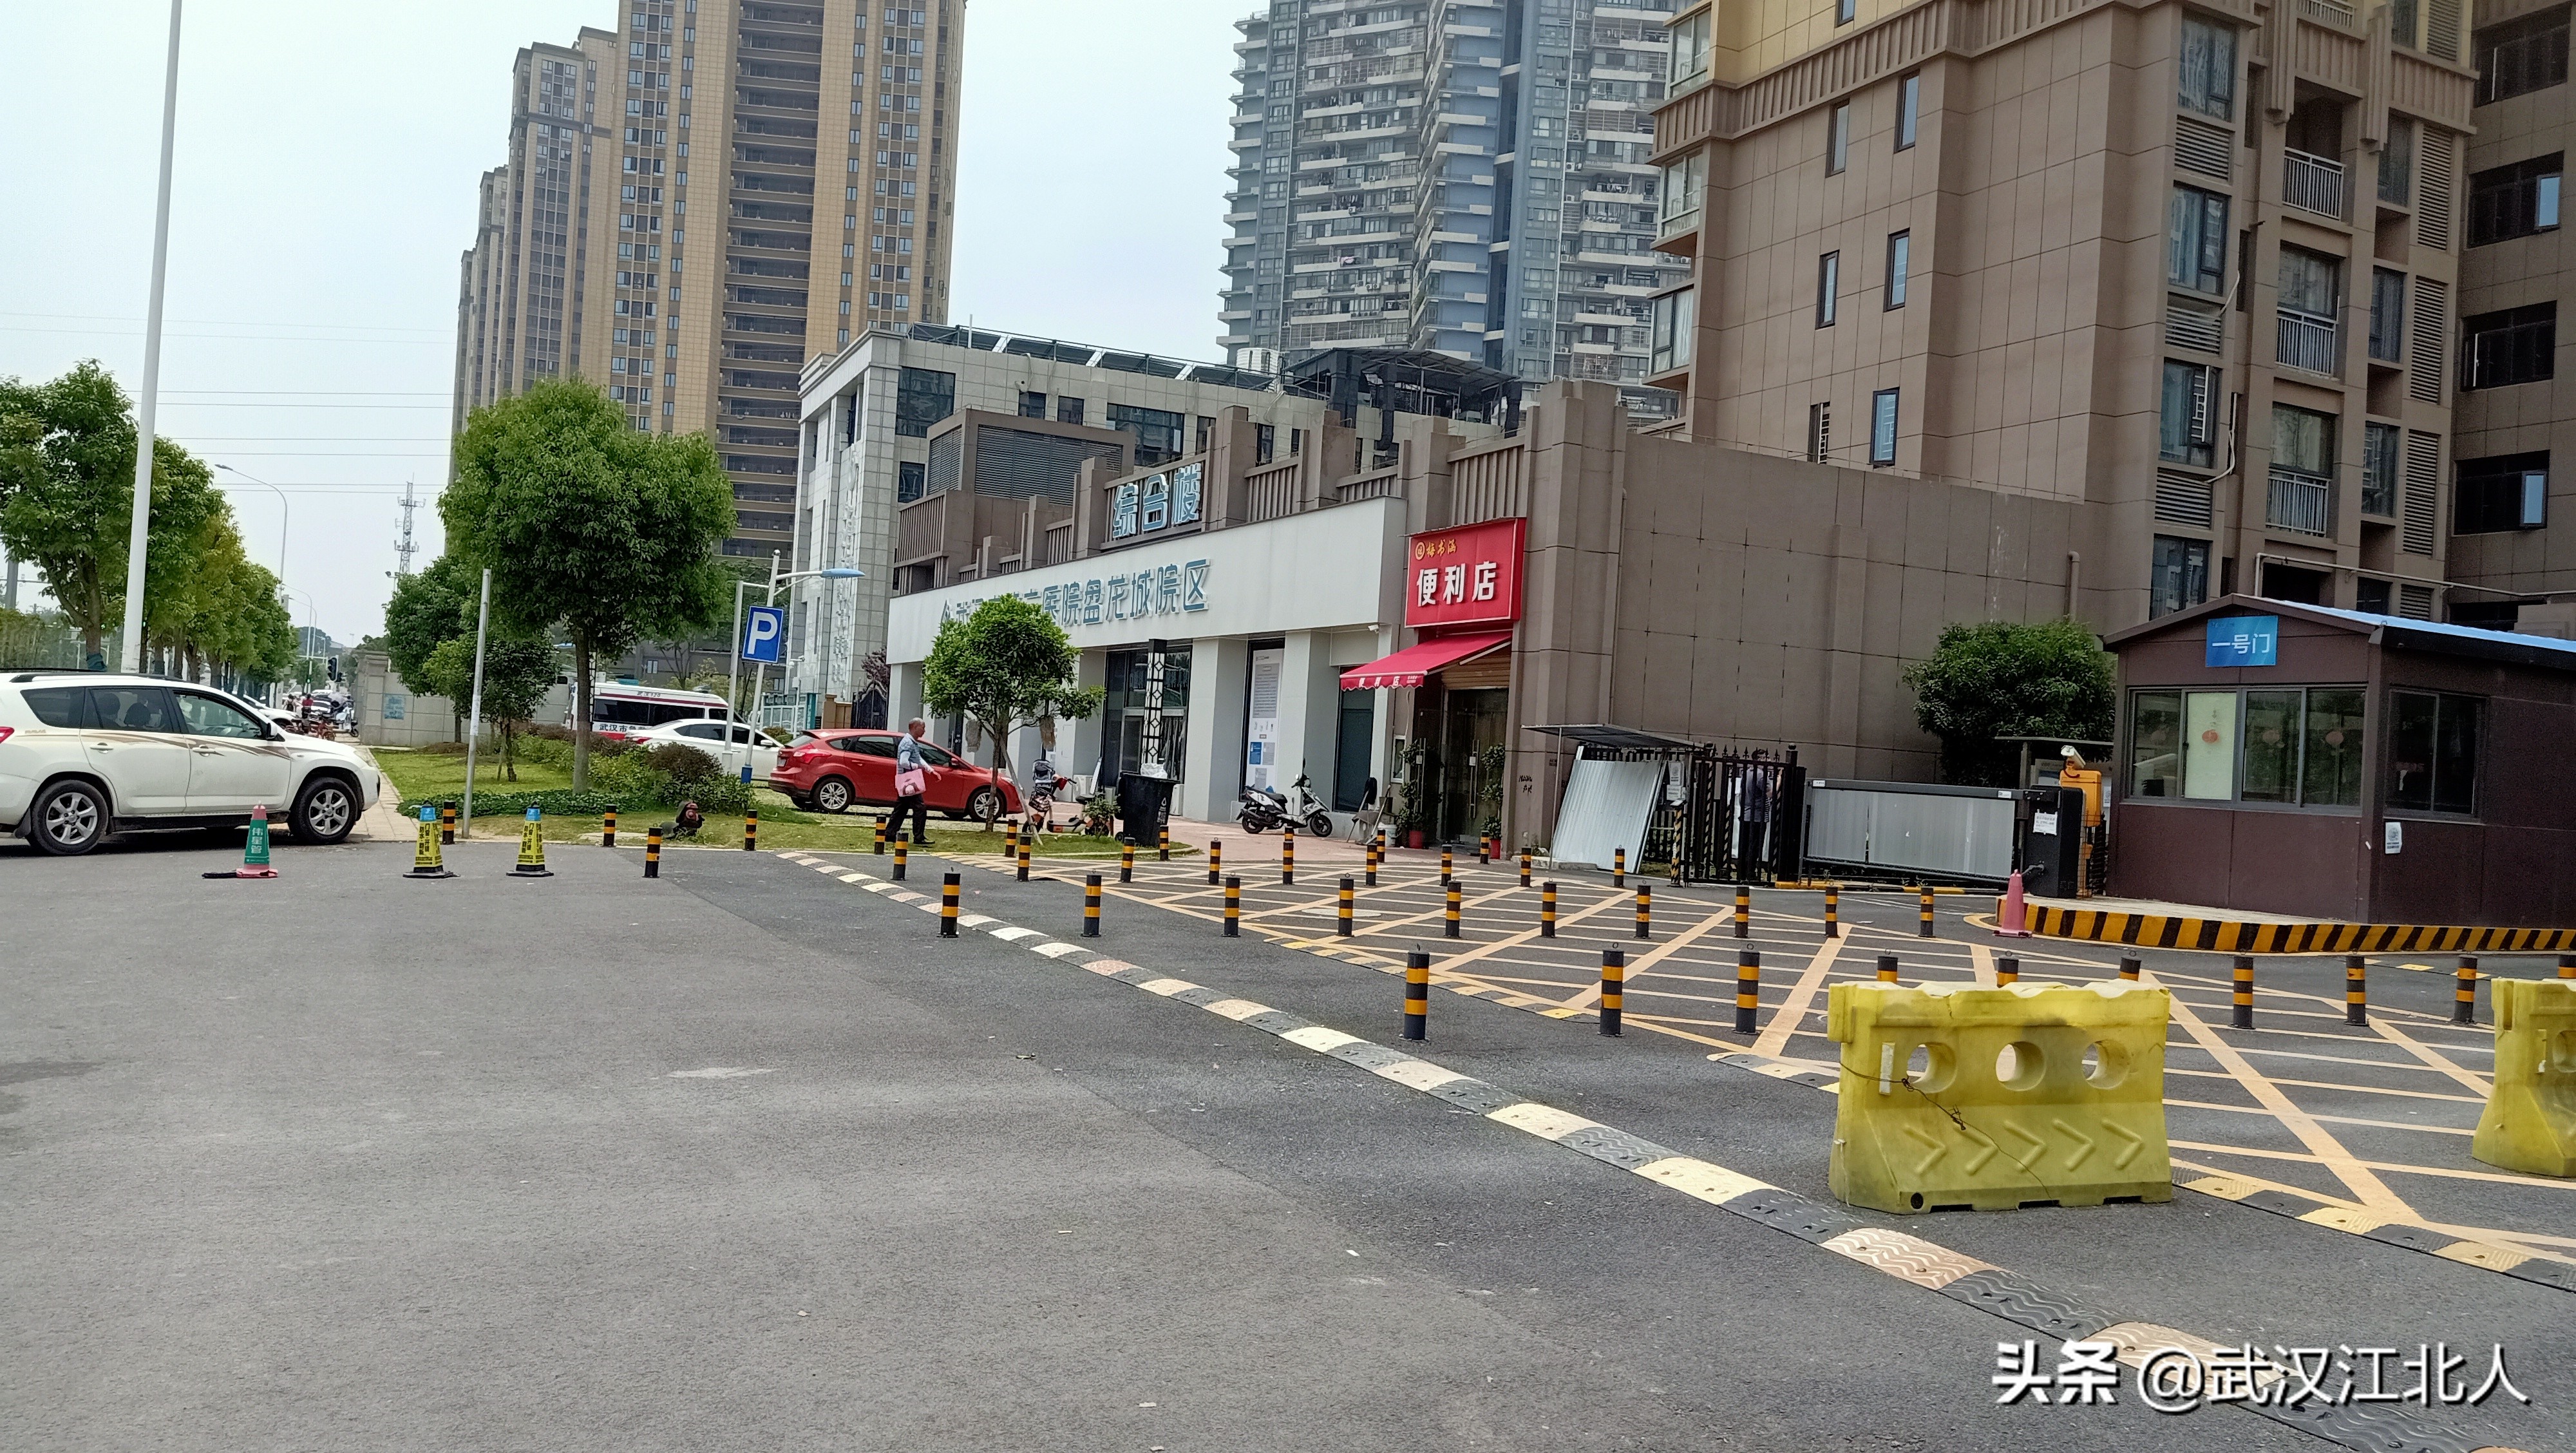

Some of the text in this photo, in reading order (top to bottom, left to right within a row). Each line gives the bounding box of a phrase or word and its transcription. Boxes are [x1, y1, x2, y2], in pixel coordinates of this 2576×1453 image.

[1113, 462, 1201, 538] 综合楼
[1416, 561, 1497, 607] 便利店
[747, 611, 778, 655] P
[2212, 634, 2270, 654] 一号门
